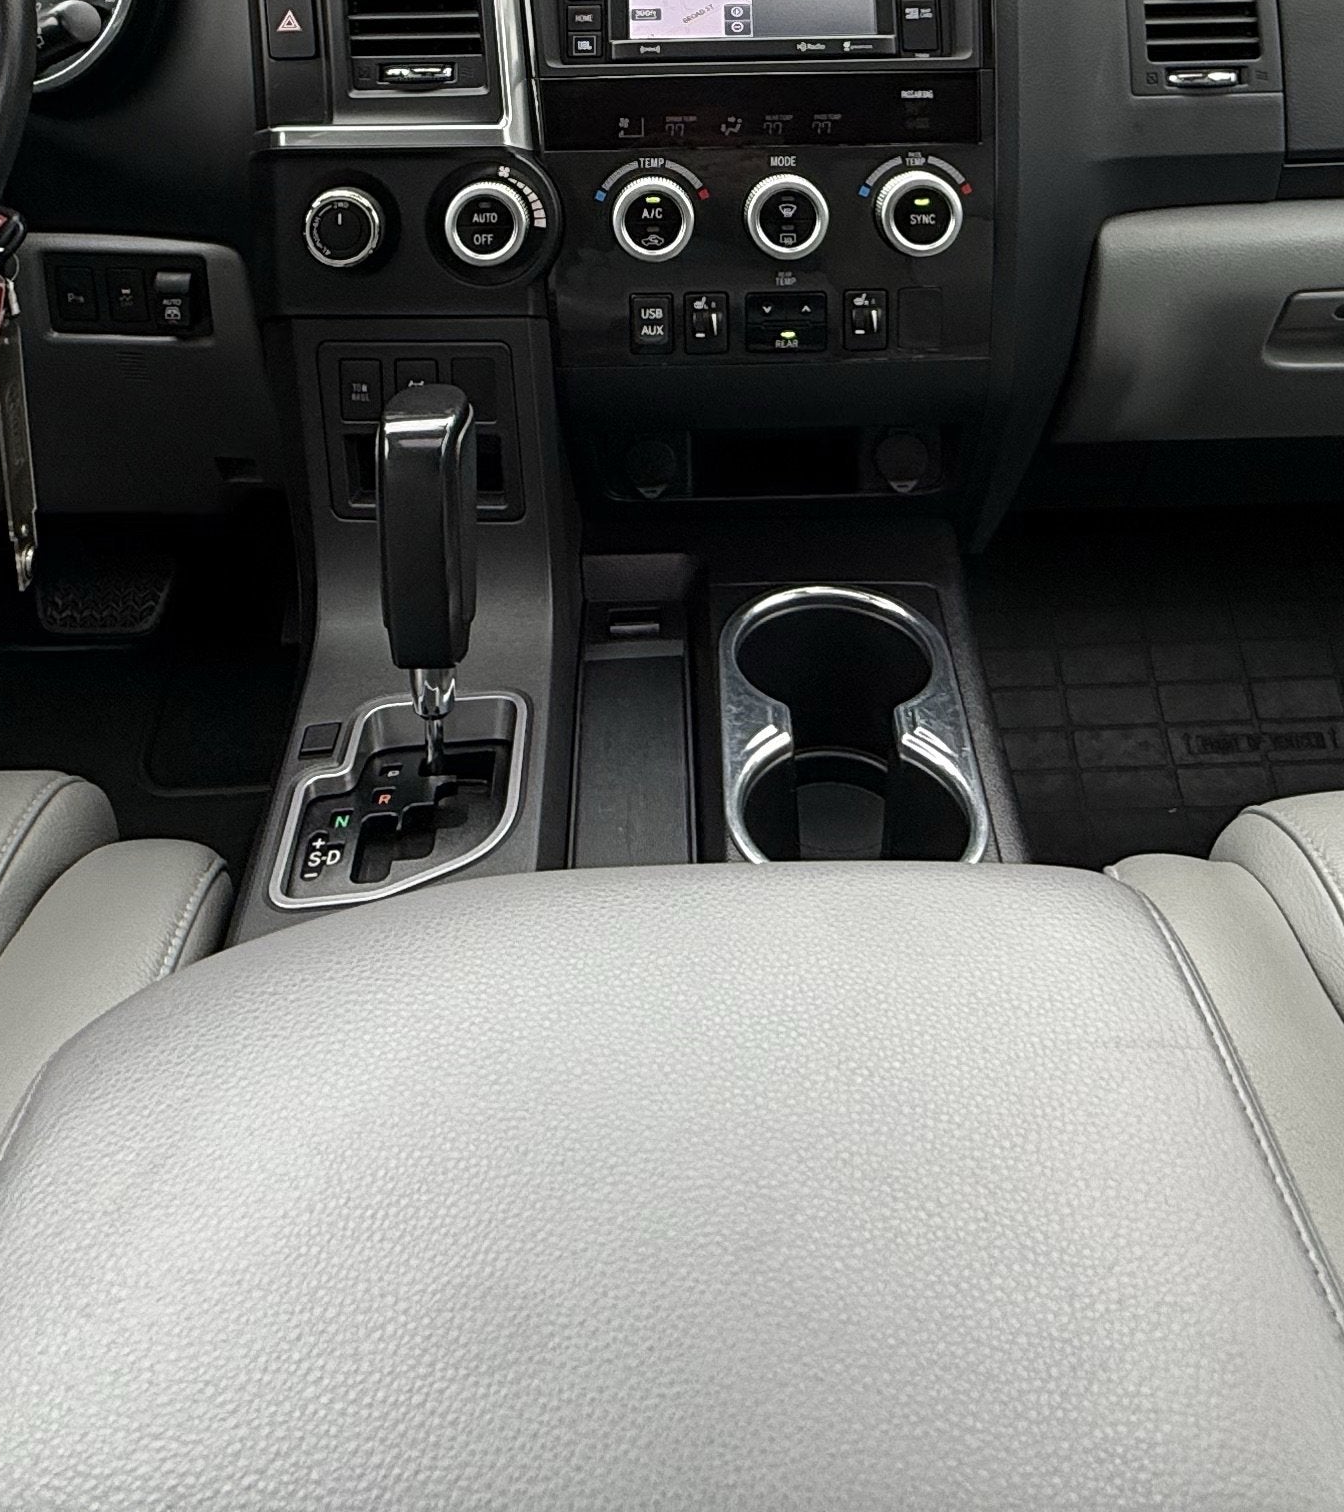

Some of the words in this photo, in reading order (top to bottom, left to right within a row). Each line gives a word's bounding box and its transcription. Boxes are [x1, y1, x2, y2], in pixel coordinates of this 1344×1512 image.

[682, 9, 705, 24] BROAD
[639, 157, 665, 168] TEMP
[770, 155, 797, 167] MODE
[905, 157, 927, 167] TEMP
[472, 212, 498, 224] AUTO
[641, 207, 663, 220] A/C
[910, 214, 936, 226] SYNC
[473, 234, 494, 245] OFF
[775, 276, 797, 286] TEMP
[641, 308, 663, 319] USB
[641, 325, 664, 336] AUX
[775, 339, 798, 349] REAR
[378, 794, 392, 805] R
[335, 815, 350, 828] N
